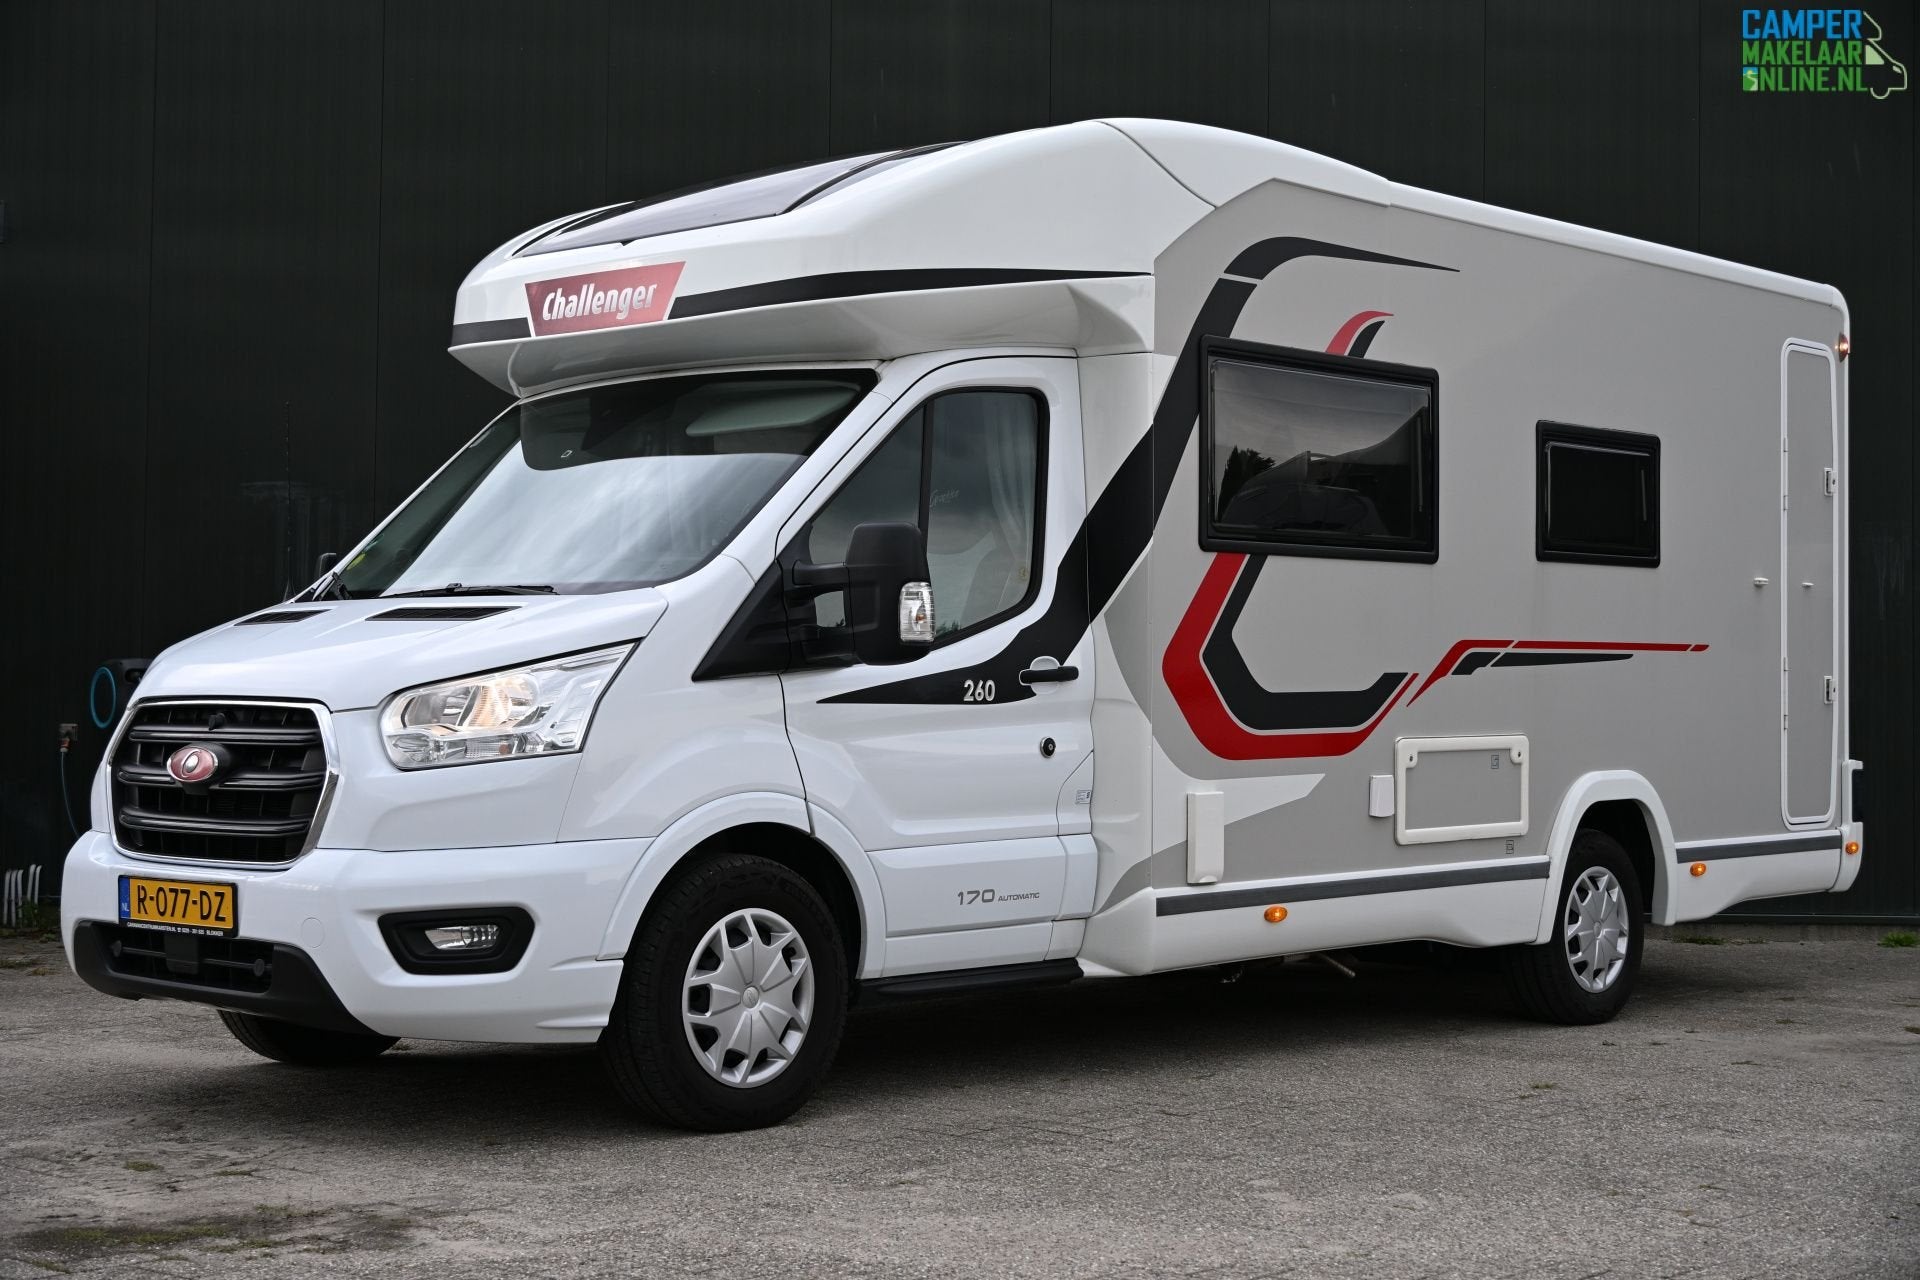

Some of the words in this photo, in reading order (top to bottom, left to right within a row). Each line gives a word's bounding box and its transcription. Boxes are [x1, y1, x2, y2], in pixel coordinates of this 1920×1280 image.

[542, 282, 658, 321] Challenger
[963, 679, 996, 702] 260
[121, 901, 130, 912] NL
[137, 884, 227, 923] R-077-DZ
[956, 888, 996, 906] 170
[997, 891, 1040, 903] AUTOMATIC
